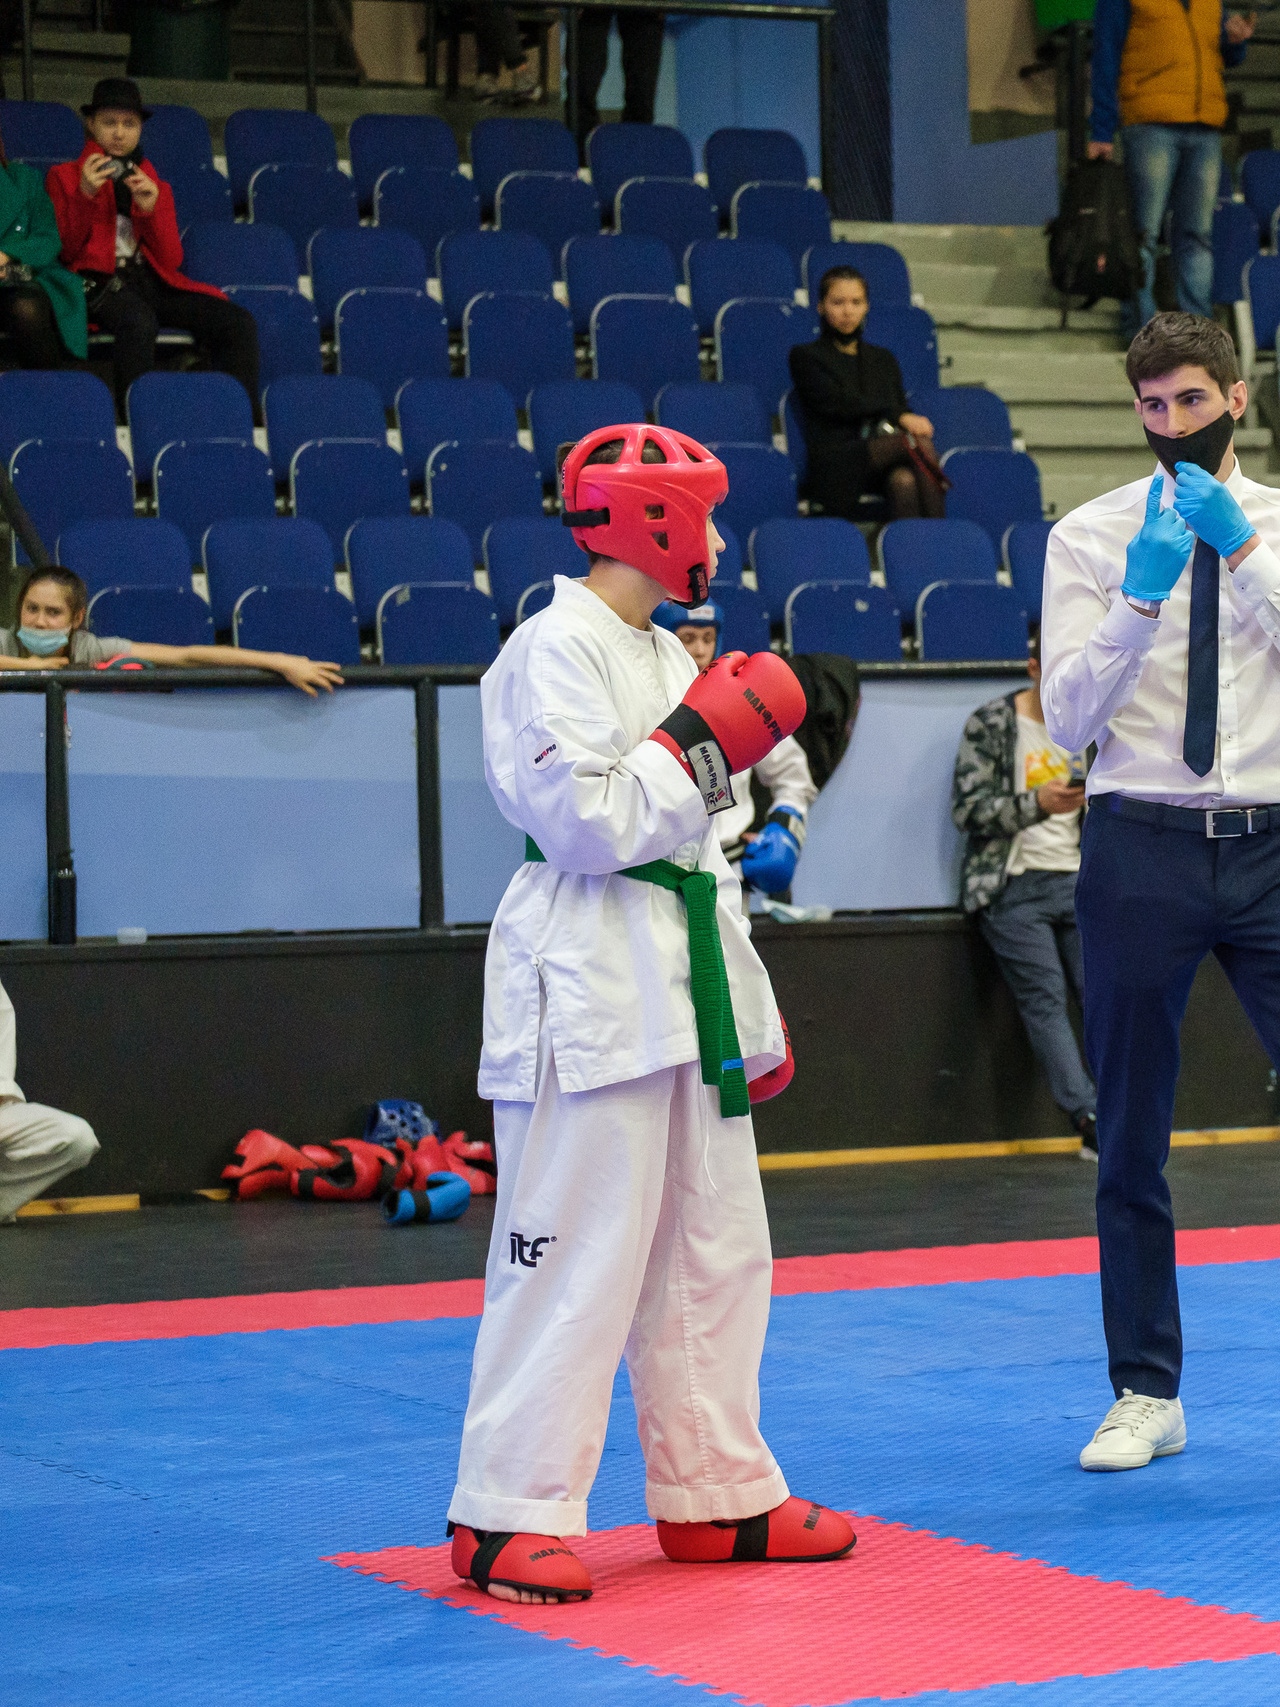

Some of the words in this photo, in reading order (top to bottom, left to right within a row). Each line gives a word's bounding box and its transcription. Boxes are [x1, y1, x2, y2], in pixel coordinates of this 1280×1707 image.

[743, 687, 767, 715] MAX
[767, 720, 784, 742] PRO
[699, 746, 714, 766] MAX
[709, 772, 718, 789] PRO
[528, 1548, 559, 1562] MAX
